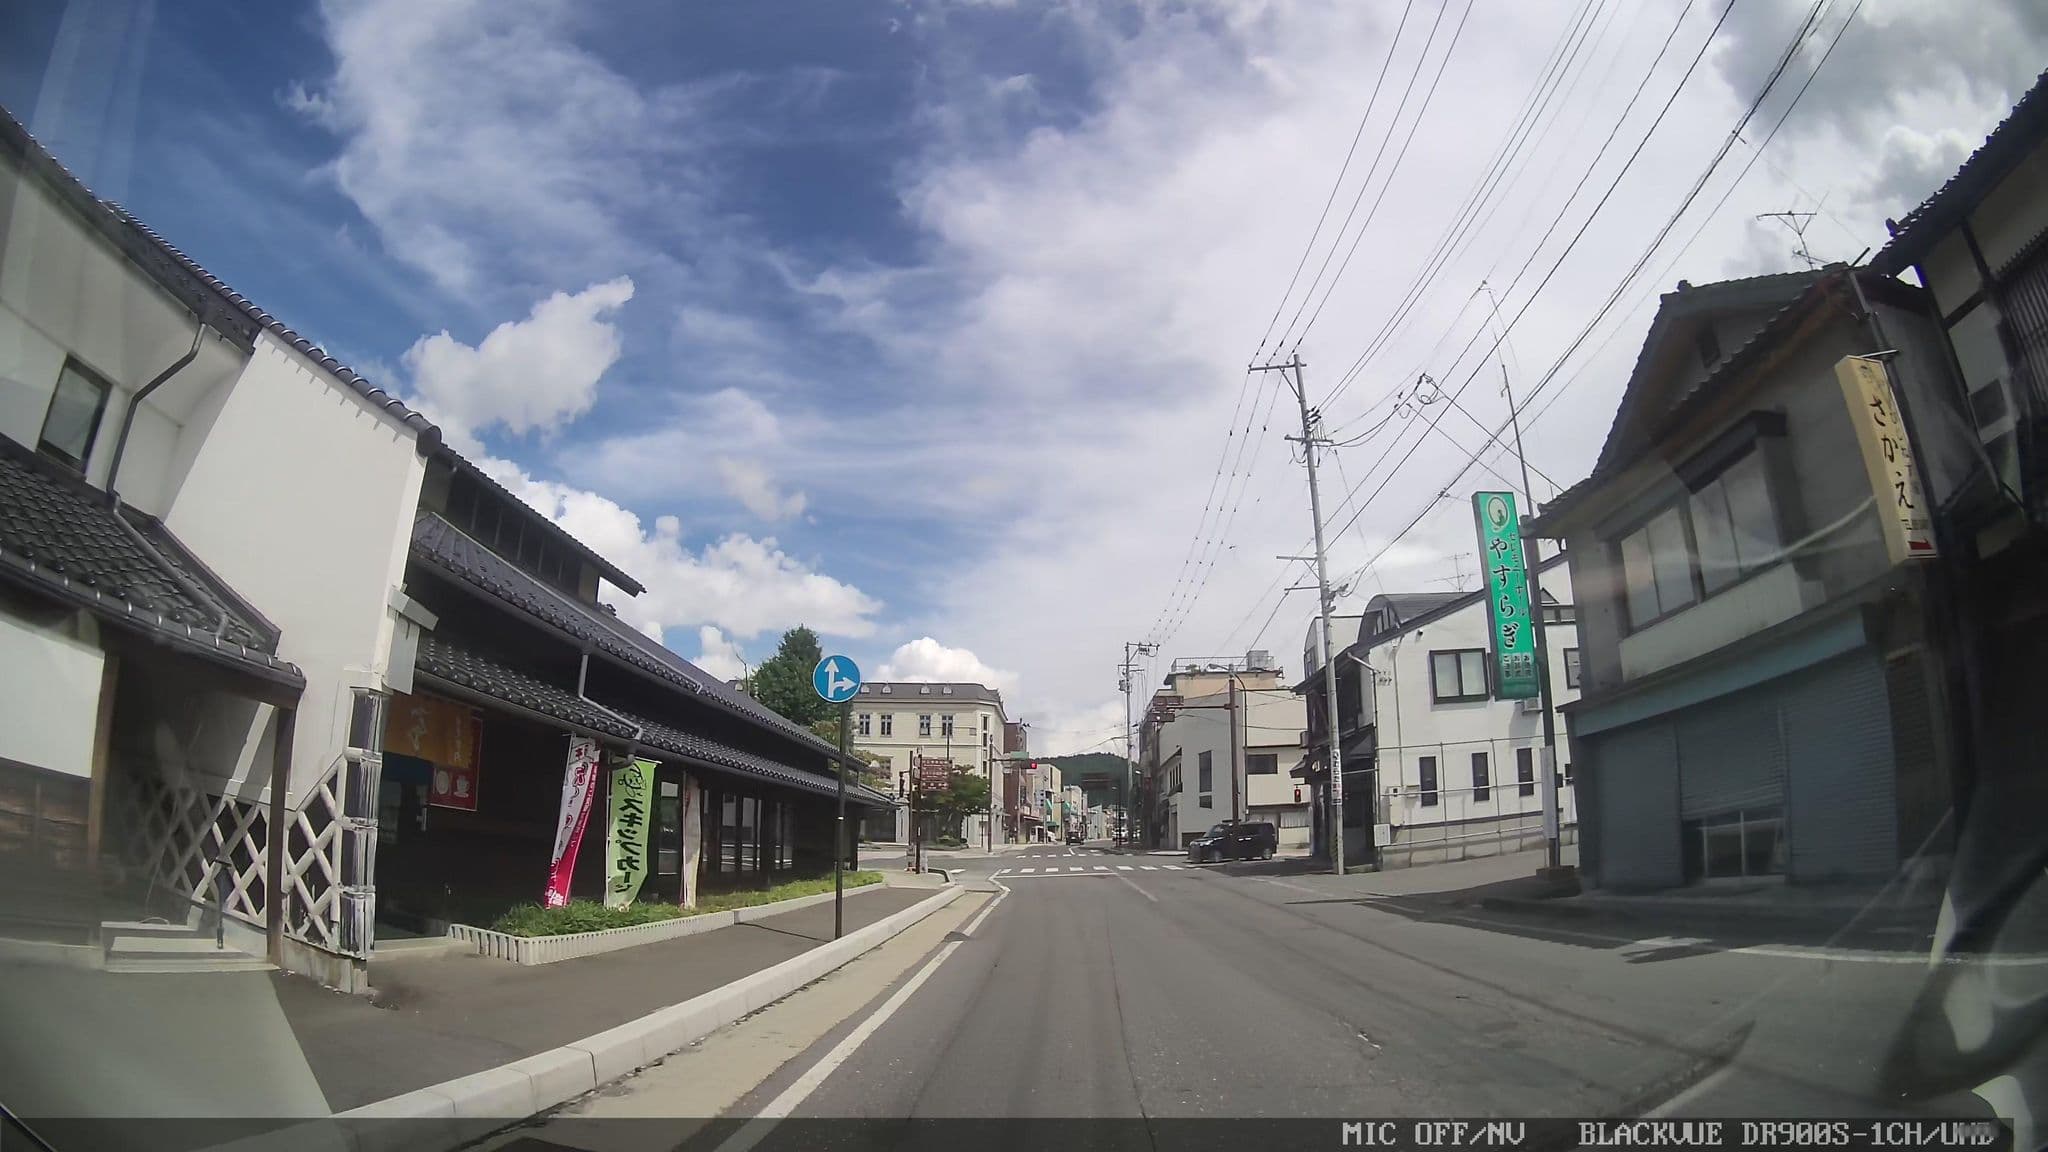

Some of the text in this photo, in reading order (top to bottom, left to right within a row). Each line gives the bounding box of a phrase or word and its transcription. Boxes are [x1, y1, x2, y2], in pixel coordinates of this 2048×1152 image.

[1869, 395, 1914, 510] さかえ
[1489, 538, 1521, 650] やすらぎ
